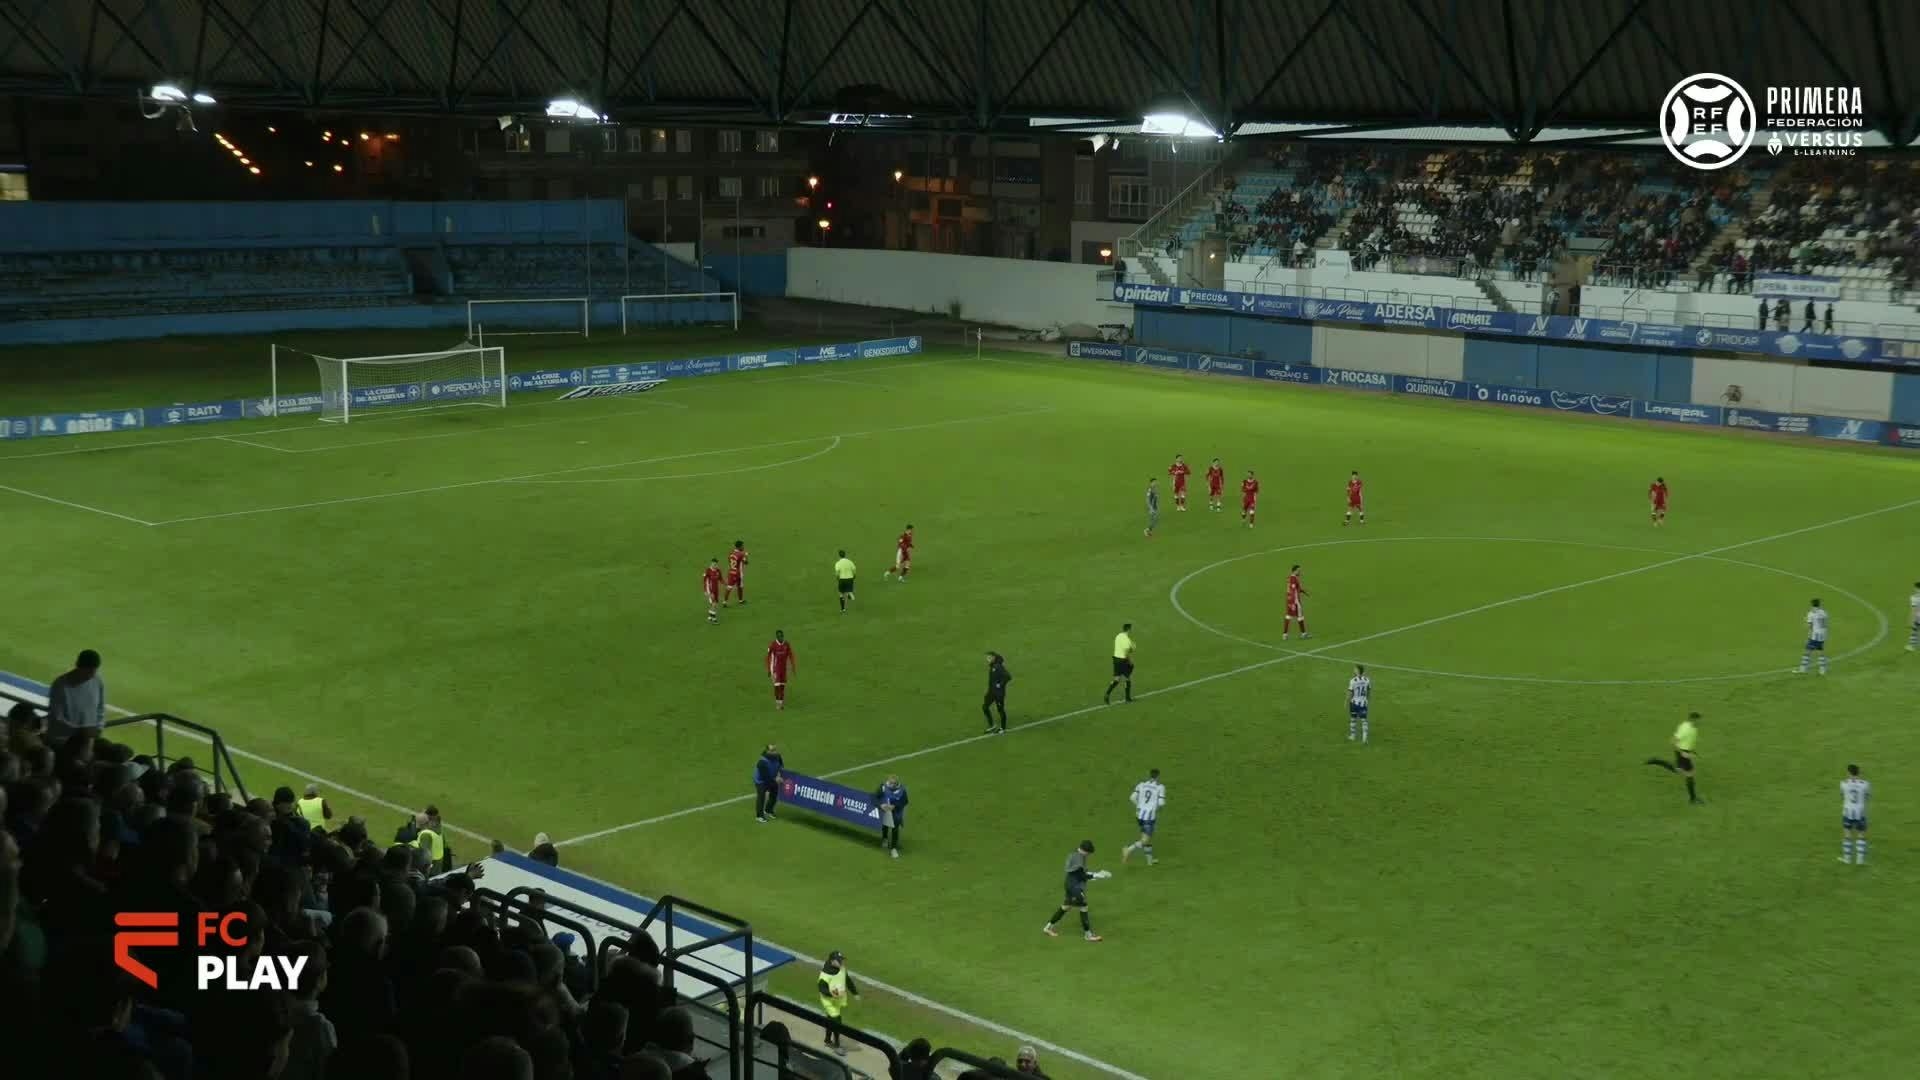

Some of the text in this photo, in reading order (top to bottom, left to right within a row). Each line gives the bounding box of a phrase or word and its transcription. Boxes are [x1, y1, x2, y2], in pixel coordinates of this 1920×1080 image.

[1124, 285, 1170, 302] pintavi
[1191, 291, 1228, 303] PRECUSA
[1375, 304, 1436, 321] ADERSA
[1715, 334, 1761, 346] TRIOCAR
[534, 377, 569, 386] ASTURIAS
[1341, 370, 1387, 385] ROCASA
[1405, 382, 1449, 397] QUIRINAL
[1496, 389, 1542, 405] innova
[187, 404, 223, 417] RAITV
[800, 785, 836, 807] FEDERACIÓN
[842, 796, 868, 812] VERSUS
[1144, 790, 1152, 804] 9
